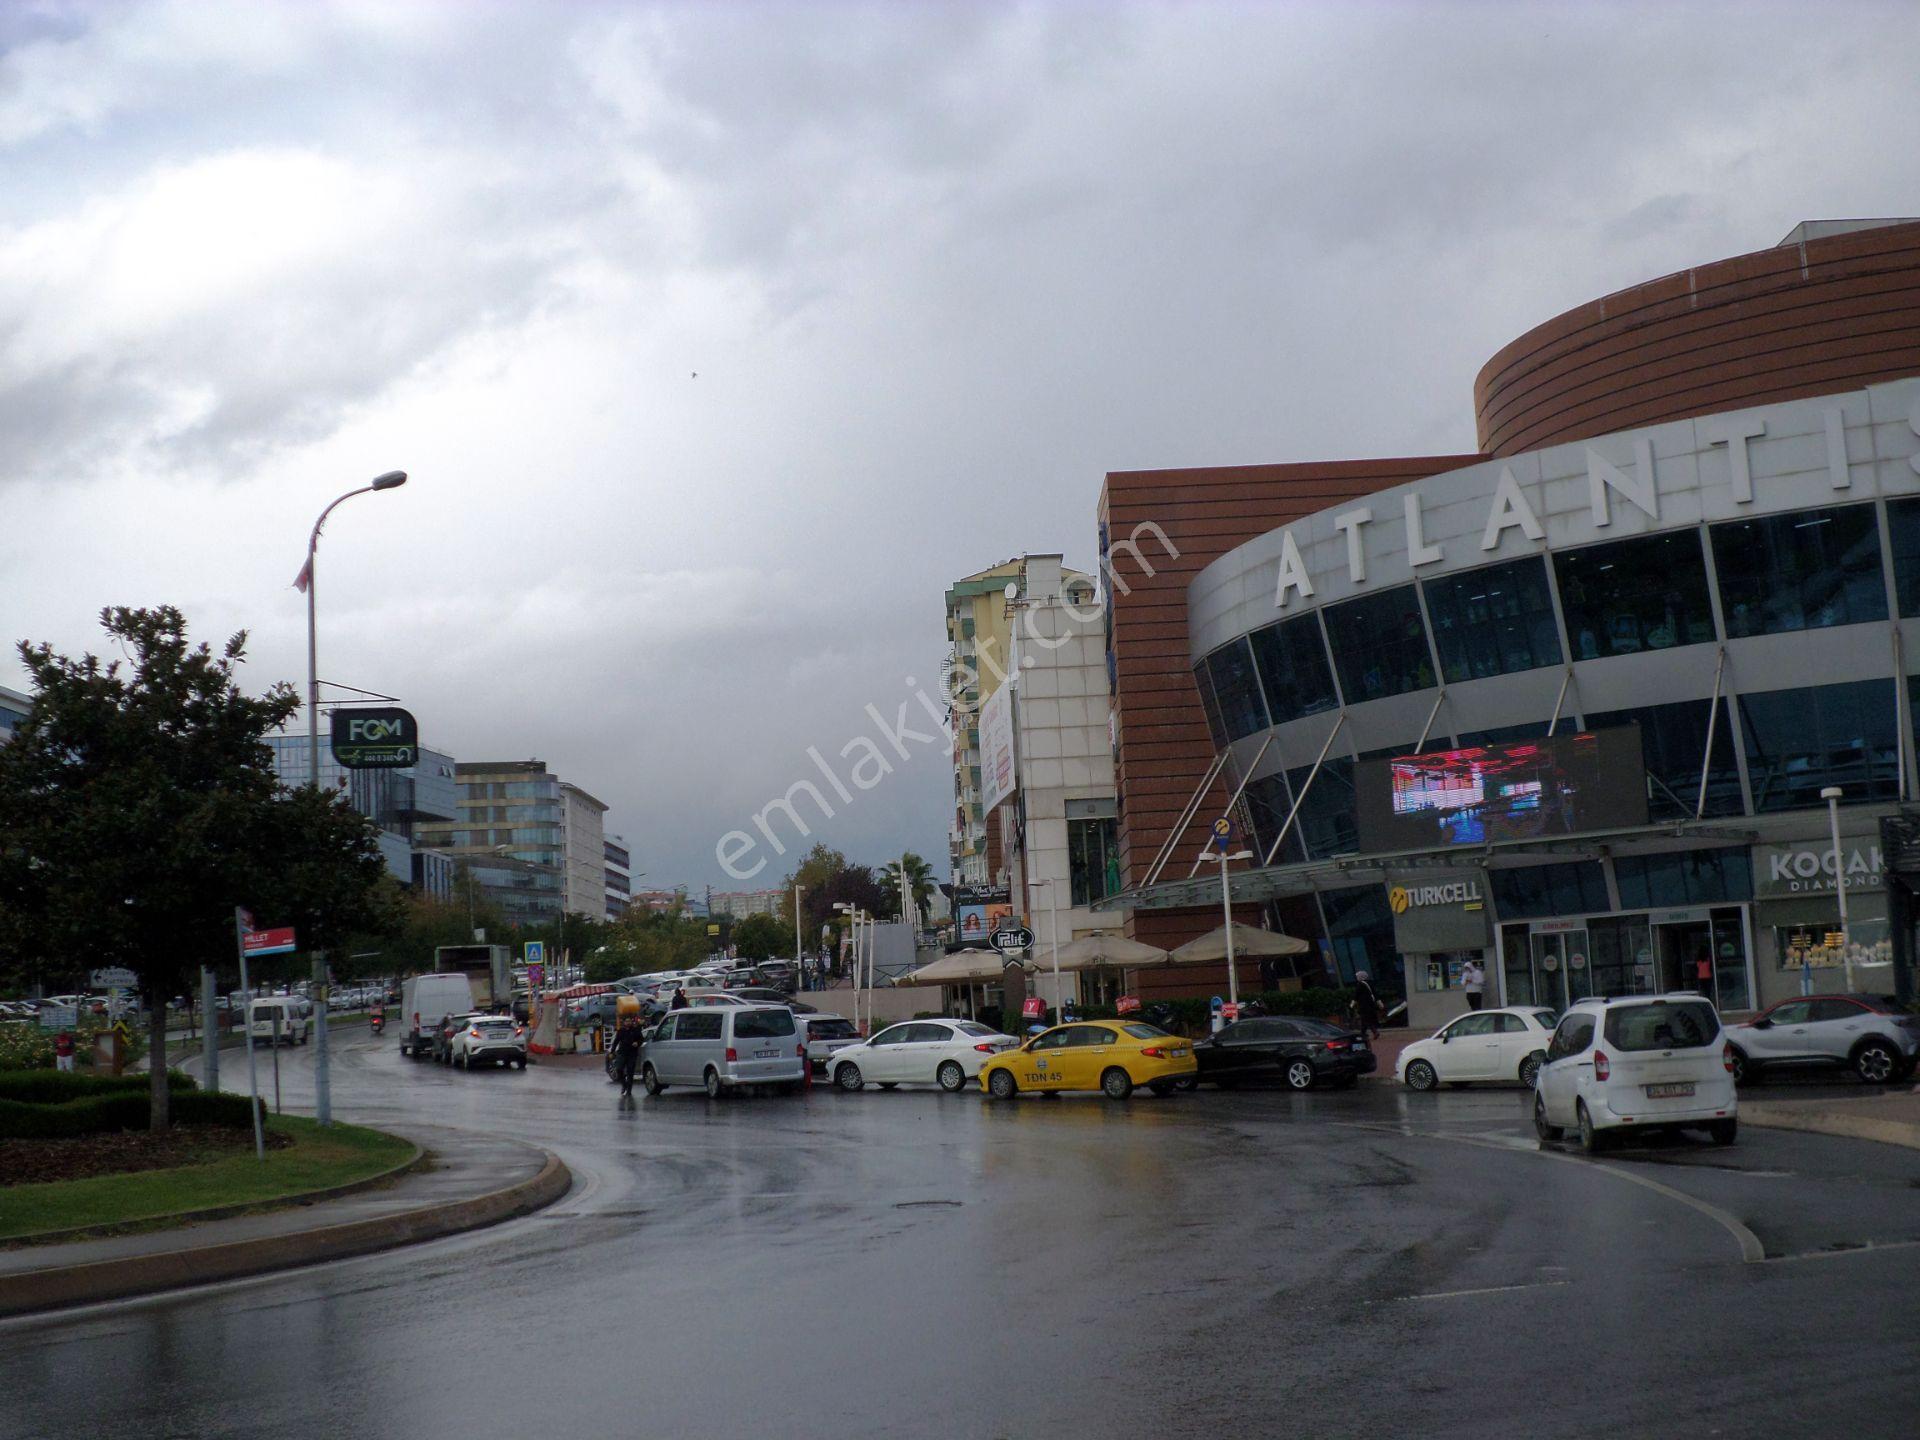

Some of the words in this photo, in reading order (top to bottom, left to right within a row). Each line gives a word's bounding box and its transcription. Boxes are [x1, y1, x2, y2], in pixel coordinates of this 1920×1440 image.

[1275, 400, 1920, 608] ATLANTI
[1405, 881, 1482, 908] TURKCELL
[1024, 1073, 1047, 1082] TDN
[1050, 1072, 1062, 1081] 45
